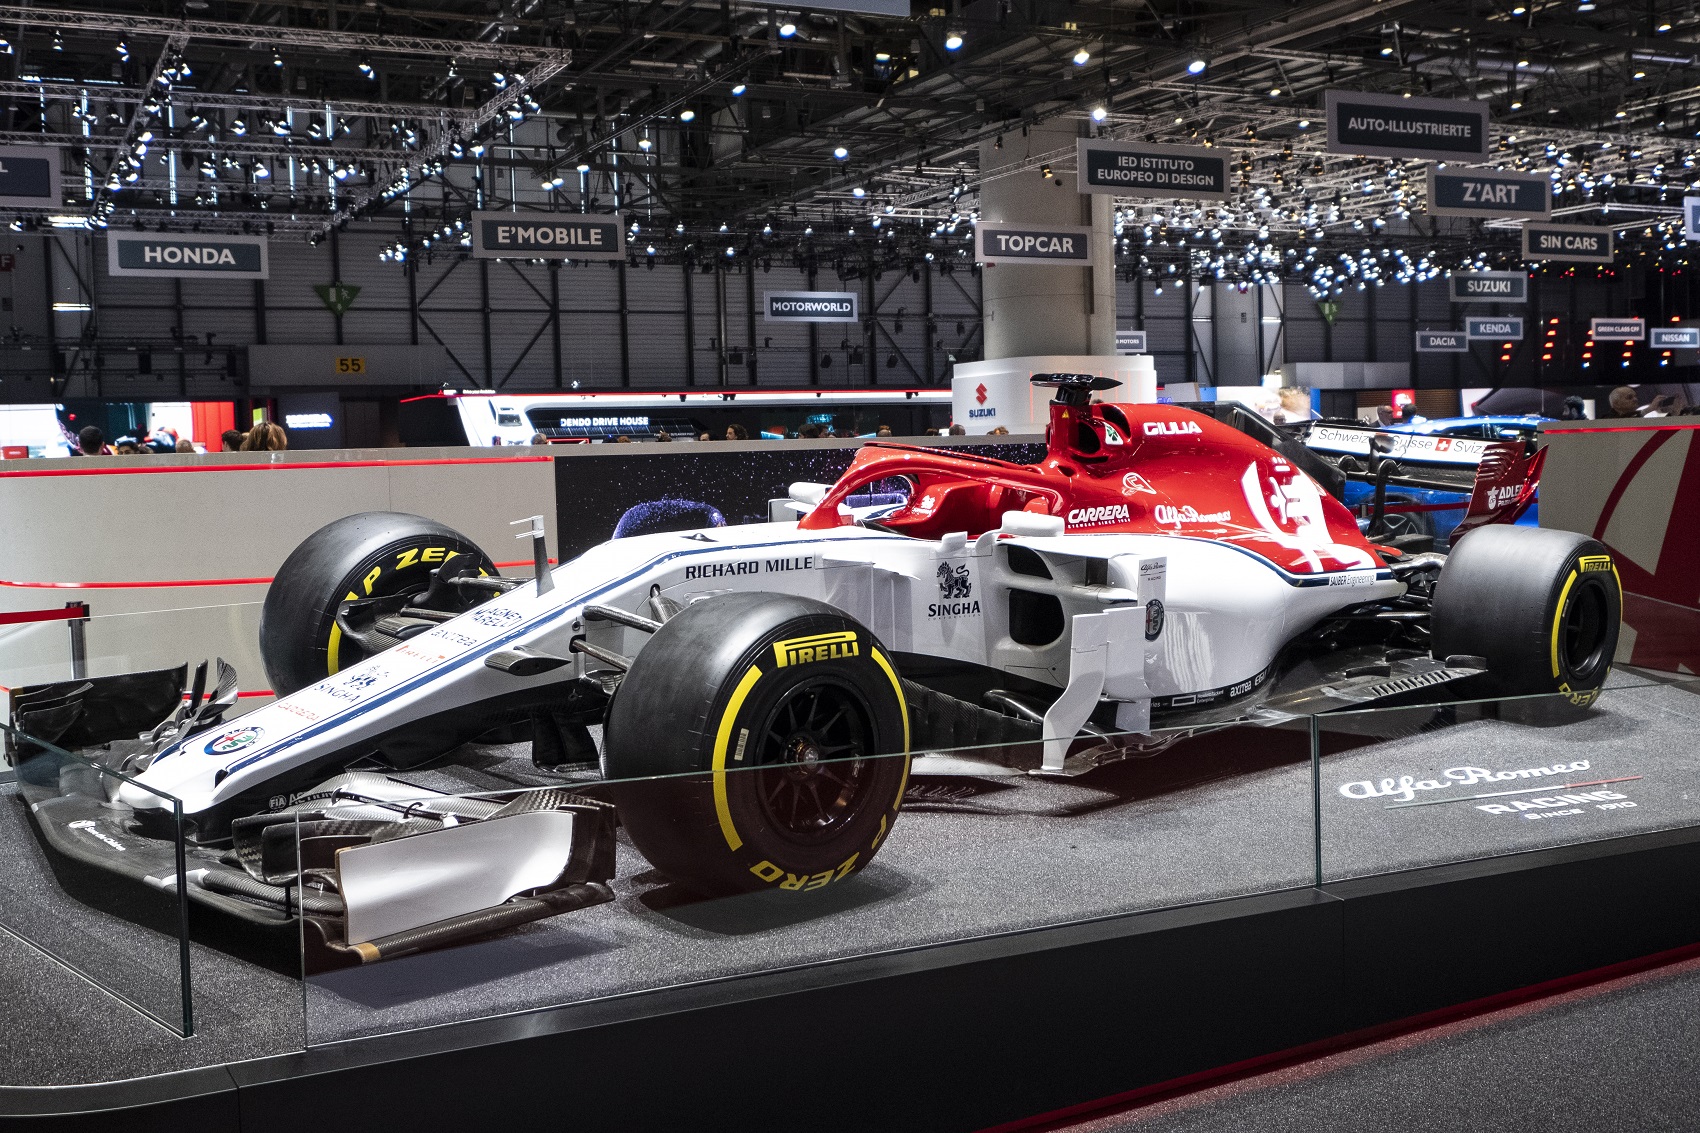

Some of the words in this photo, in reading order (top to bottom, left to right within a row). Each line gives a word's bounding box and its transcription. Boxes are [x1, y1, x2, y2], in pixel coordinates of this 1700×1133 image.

[1348, 117, 1472, 137] AUTO-ILLUSTRIERTE
[1118, 156, 1137, 167] IED
[1140, 157, 1194, 171] ISTITUTO
[1097, 169, 1154, 183] EUROPEO
[1156, 172, 1168, 183] DI
[1171, 173, 1215, 186] DESIGN
[997, 234, 1073, 253] TOPCAR
[1540, 235, 1562, 249] SIN
[1564, 236, 1598, 251] CARS
[144, 246, 236, 265] HONDA
[1467, 280, 1511, 293] SUZUKI
[772, 302, 851, 313] MOTORWORLD
[1479, 323, 1511, 334] KENDA
[1430, 337, 1456, 346] DACIA
[1661, 333, 1690, 343] NISSAN
[340, 358, 361, 373] 55
[969, 408, 996, 418] SUZUKI
[560, 418, 591, 427] DENDO
[592, 417, 618, 427] DRIVE
[619, 416, 649, 426] HOUSE
[1143, 421, 1203, 436] GIULIA
[1318, 429, 1369, 445] Schweiz
[1068, 504, 1129, 523] CARRERA
[1154, 505, 1186, 529] Alfa
[1183, 505, 1231, 522] Romeo
[685, 561, 760, 579] RICHARD
[765, 556, 813, 573] MILLE
[1578, 555, 1610, 573] PIRELLI
[363, 566, 382, 596] P
[1330, 575, 1347, 586] SAUBER
[1347, 574, 1374, 587] Engineering
[927, 601, 981, 617] SINGHA
[773, 631, 860, 668] PIRELLI
[314, 682, 360, 703] SINGHA
[1339, 775, 1452, 802] Alfa
[1444, 759, 1590, 785] Romeo
[270, 797, 286, 808] FIA
[1475, 790, 1628, 815] RACING
[1523, 808, 1585, 820] SINCE
[1595, 801, 1638, 811] 1910
[749, 851, 860, 892] ZERO
